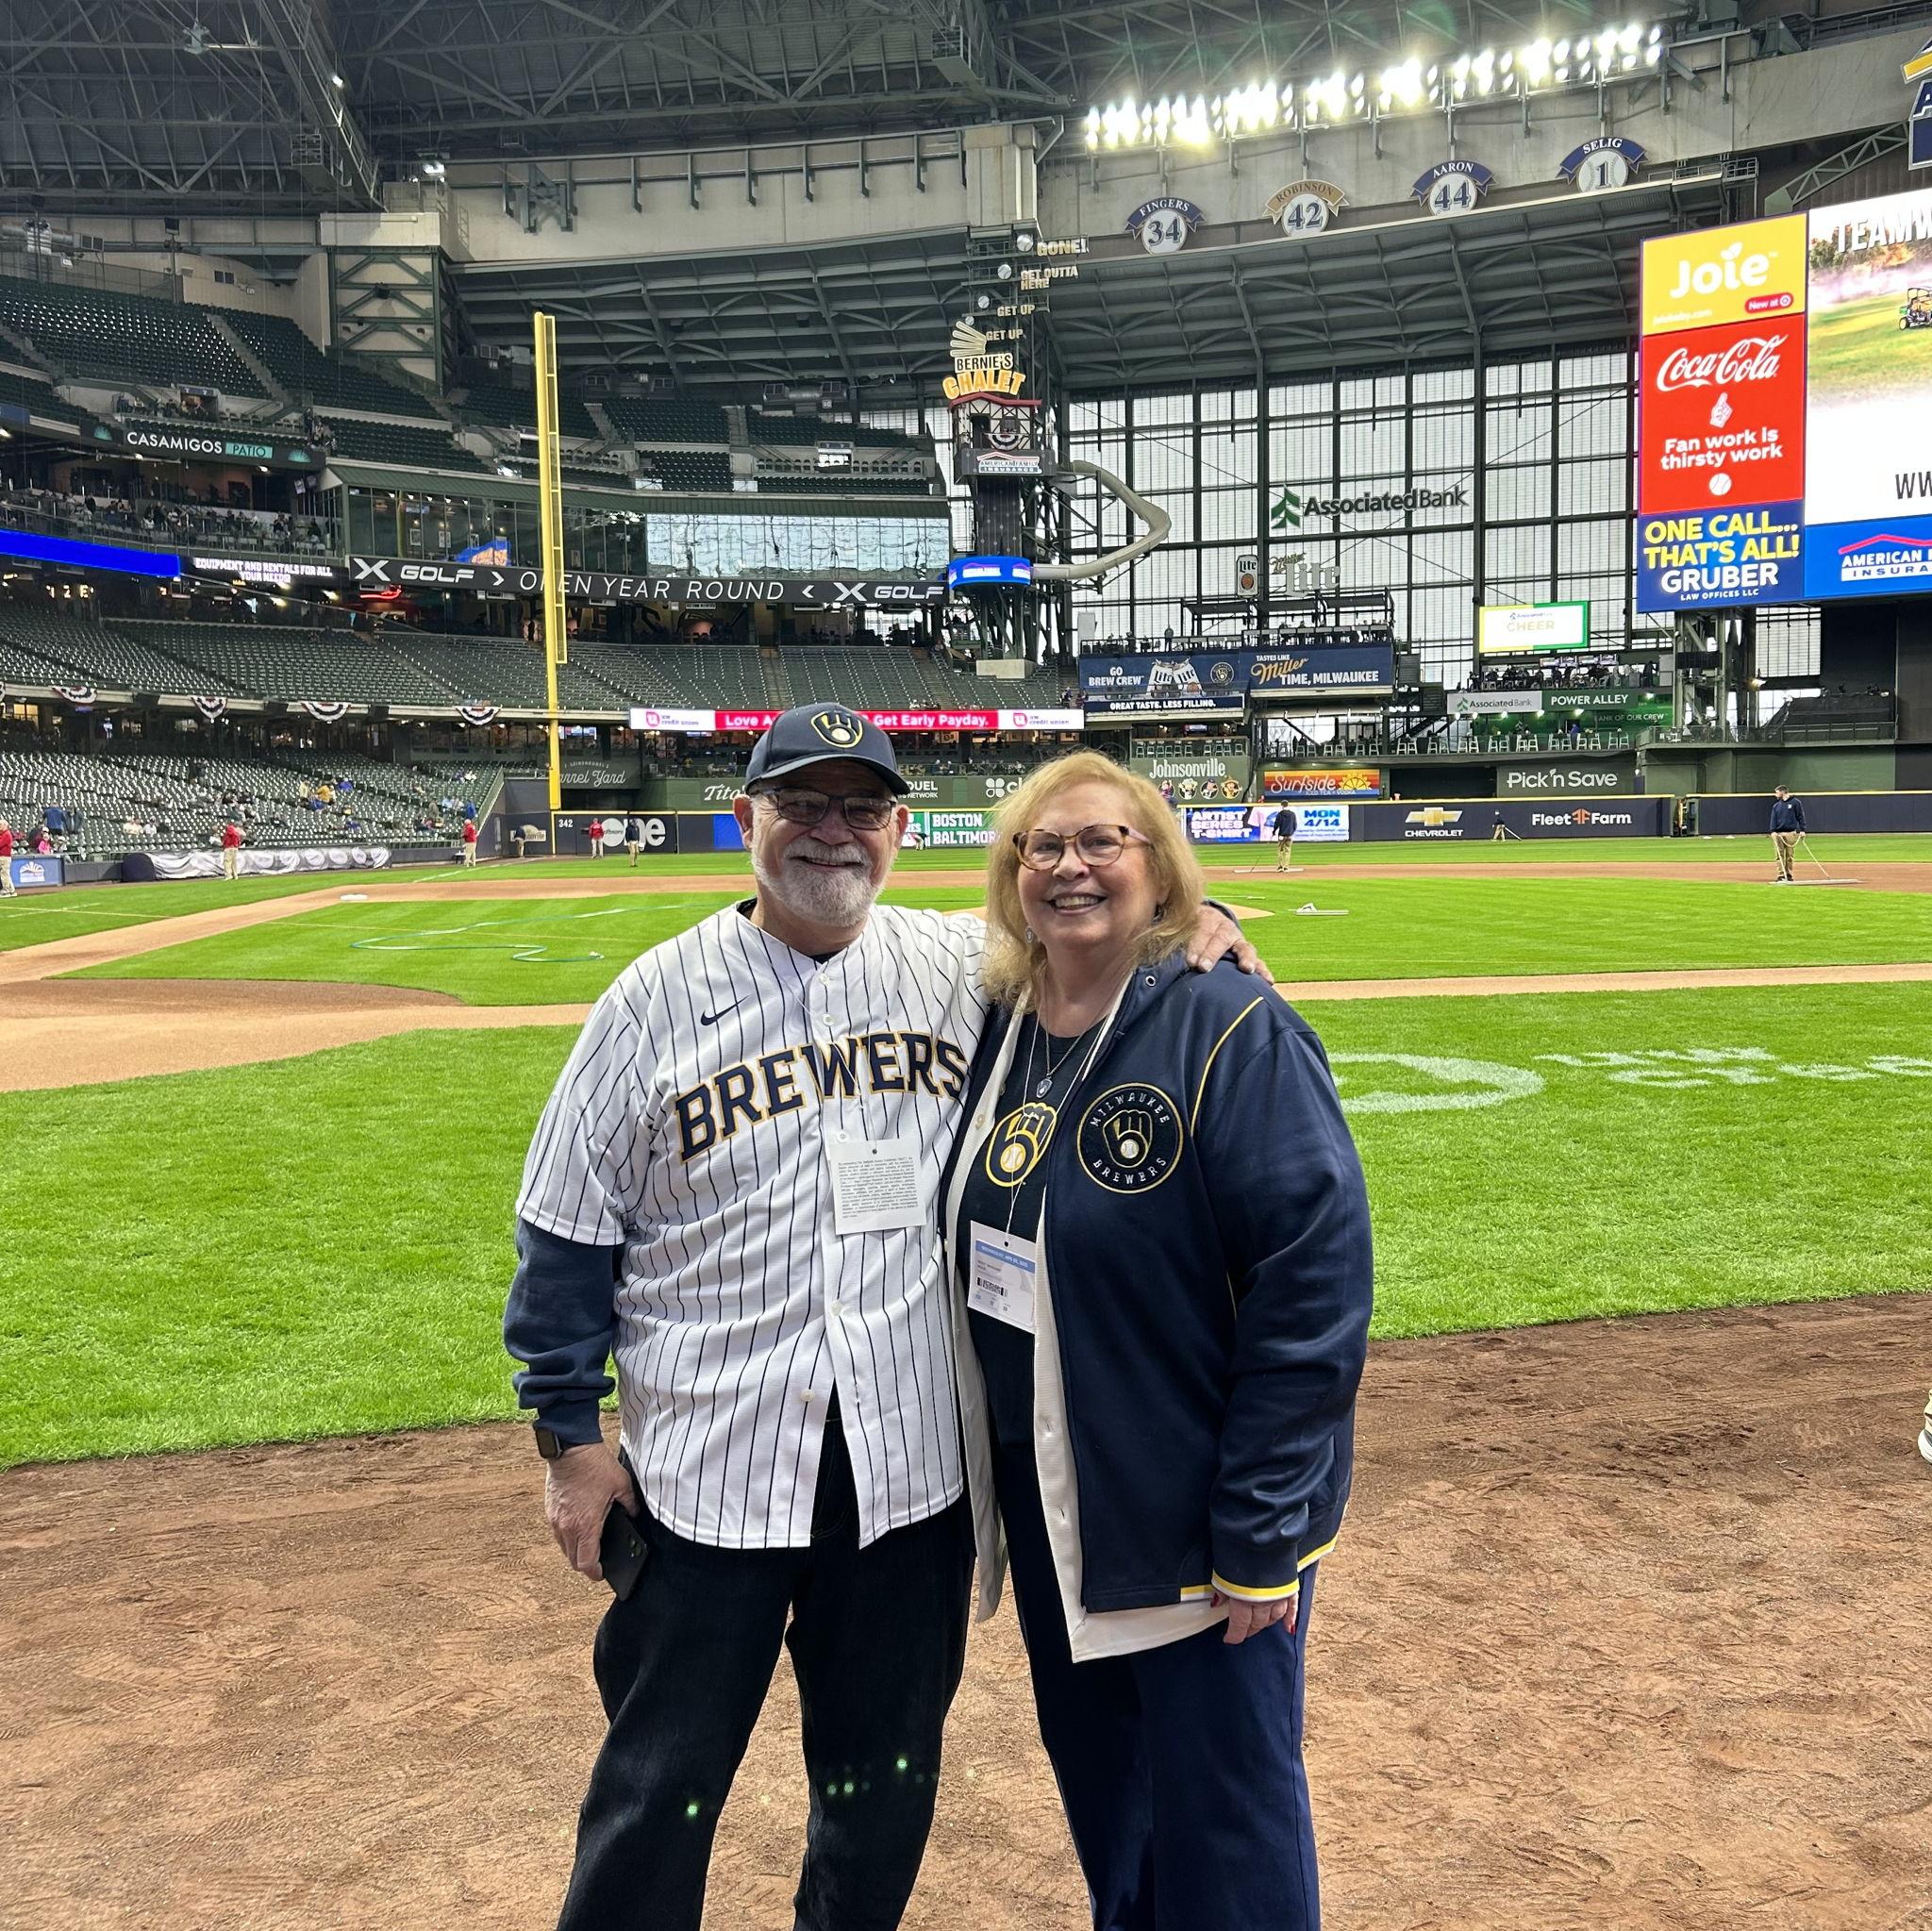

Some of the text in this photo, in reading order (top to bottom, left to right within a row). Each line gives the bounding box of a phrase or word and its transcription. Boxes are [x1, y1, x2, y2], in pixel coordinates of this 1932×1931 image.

[1583, 138, 1623, 155] SELIG
[1433, 161, 1474, 179] AARON
[1596, 160, 1612, 189] 1
[1275, 183, 1334, 203] ROBINSON
[1434, 179, 1472, 211] 44
[1139, 198, 1191, 217] FINGERS
[1288, 202, 1323, 230] 42
[1147, 218, 1183, 247] 34
[1037, 238, 1087, 257] GONE!
[1020, 265, 1078, 281] GET OUTTA
[1669, 241, 1771, 299] Joie
[996, 304, 1036, 317] GET UP
[1749, 299, 1779, 310] New at
[985, 328, 1024, 341] GET UP
[957, 354, 1012, 371] BERNIE'S
[1657, 334, 1789, 392] Coca-Cola
[941, 368, 1026, 400] CHALET
[126, 431, 267, 458] CASAMIGOS PATIO
[1665, 426, 1779, 454] Fan work is
[1660, 443, 1783, 471] thirsty work
[1304, 485, 1469, 517] Associated Bank
[1644, 510, 1798, 543] ONE CALL...
[1643, 534, 1800, 570] THAT'S ALL!
[1841, 549, 1923, 568] AMERICAN
[316, 566, 333, 577] ALL
[1239, 560, 1257, 574] Lite
[353, 558, 944, 602] X GOLF OEN YEAR ROUND X GOLF
[1284, 563, 1341, 598] Lite
[1660, 561, 1779, 593] GRUBER
[1680, 593, 1700, 602] LAW
[1701, 591, 1740, 600] OFFICES
[1507, 620, 1556, 632] CHEER
[1109, 666, 1124, 676] GO
[1250, 658, 1309, 686] Miller
[1279, 670, 1379, 686] TIME, MILWAUKEE
[1089, 675, 1116, 687] BREW
[1109, 701, 1137, 710] GREAT
[1162, 700, 1182, 708] LESS
[1469, 698, 1533, 708] Associated Bank
[1551, 695, 1591, 707] POWER
[1594, 693, 1629, 705] ALLEY
[724, 714, 759, 726] Love
[874, 713, 989, 729] Get Early Payday.
[1149, 757, 1227, 779] Johnsonville
[591, 770, 626, 788] Yard
[1270, 774, 1337, 793] Surfside
[1568, 770, 1618, 788] Save
[704, 783, 747, 801] Tito'
[932, 813, 983, 827] BOSTON
[1191, 810, 1246, 821] ARTIST
[1304, 809, 1341, 818] MON
[1304, 818, 1341, 827] 4/14
[1532, 812, 1632, 826] Fleet Farm
[558, 819, 574, 829] 342
[1191, 820, 1244, 829] SERIES
[1191, 827, 1253, 839] T-SHIRT
[932, 829, 1000, 845] BALTIMOR
[1404, 829, 1464, 838] CHEVROLET
[675, 1030, 969, 1163] BREWERS
[1090, 1092, 1171, 1127] MILWAUKEE
[1092, 1157, 1167, 1185] BREWERS
